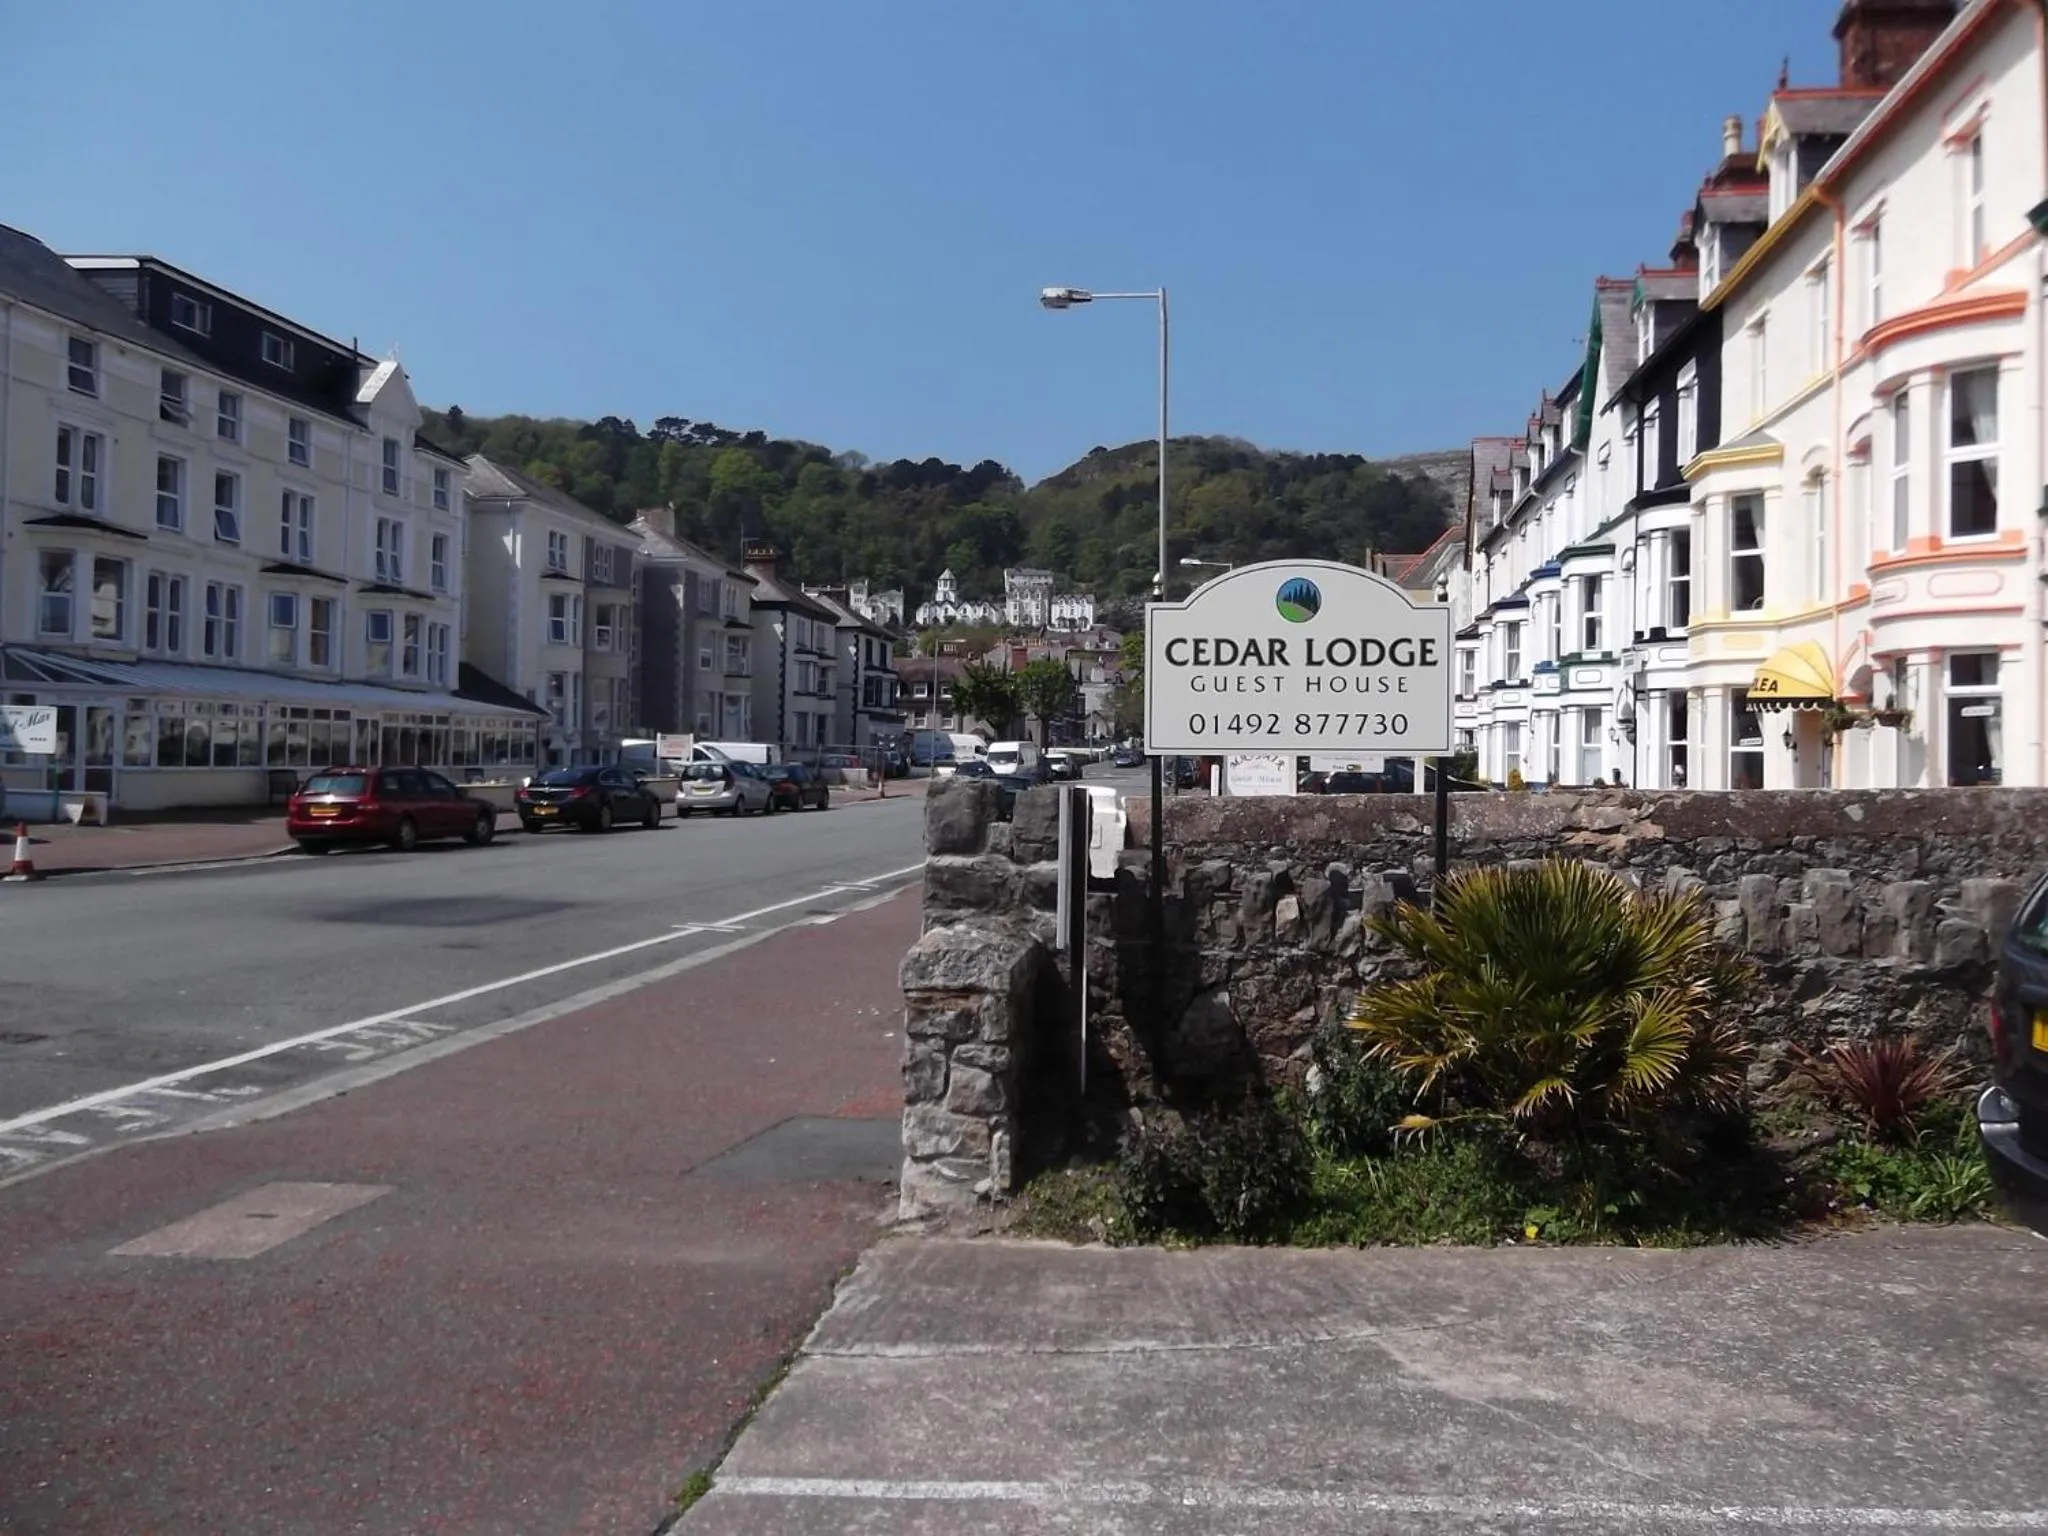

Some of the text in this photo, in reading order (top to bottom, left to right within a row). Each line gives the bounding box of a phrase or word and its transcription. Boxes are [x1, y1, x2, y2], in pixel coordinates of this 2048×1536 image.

[1165, 638, 1438, 667] CEDAR LODGE
[1190, 675, 1409, 693] GUEST HOUSE
[1189, 713, 1409, 735] 01492 877730
